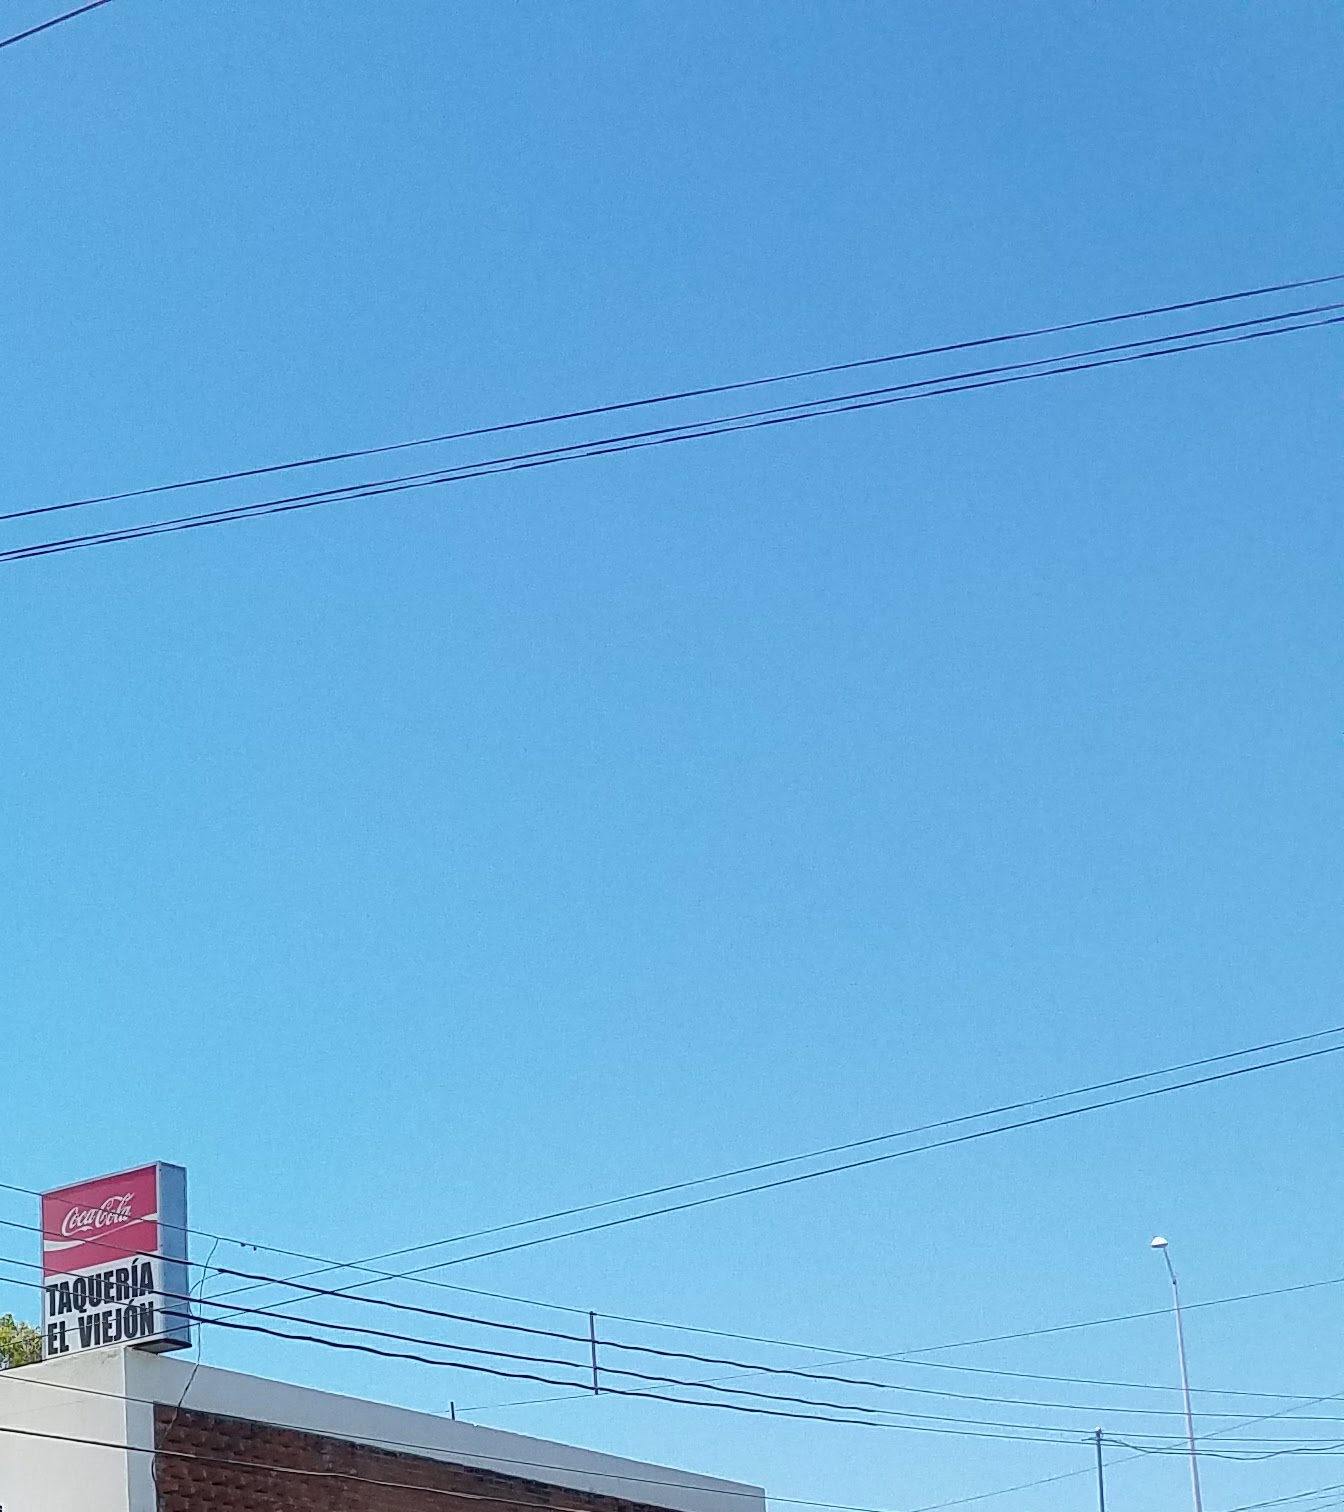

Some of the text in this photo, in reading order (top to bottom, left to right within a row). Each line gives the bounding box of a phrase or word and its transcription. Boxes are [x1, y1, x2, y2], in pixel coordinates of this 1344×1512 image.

[62, 1192, 135, 1237] Coca-Cola
[46, 1258, 155, 1317] TAQUERÍA
[47, 1298, 154, 1356] EL VIEJÓN
